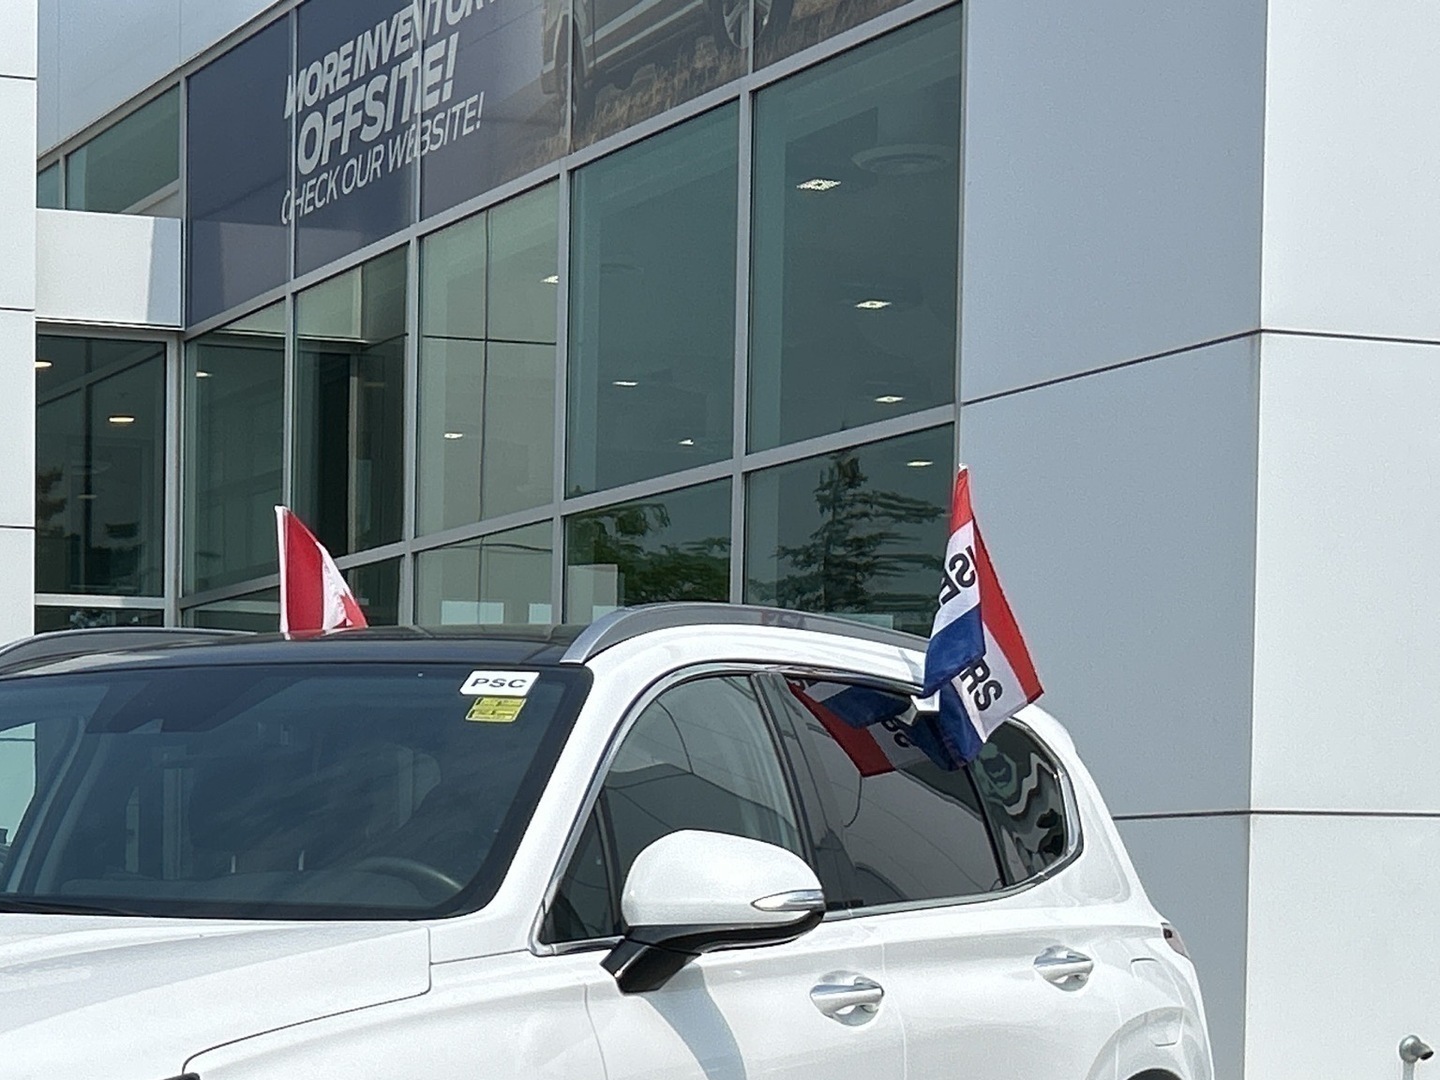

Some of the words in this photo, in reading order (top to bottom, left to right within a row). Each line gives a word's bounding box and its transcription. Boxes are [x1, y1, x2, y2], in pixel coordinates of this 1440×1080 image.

[284, 39, 354, 120] MORE
[353, 0, 496, 80] INVENTO
[297, 32, 459, 175] OFFSITE!
[281, 166, 343, 225] CHECK
[341, 143, 384, 195] OUR
[388, 91, 485, 173] WEBSITE!
[470, 677, 527, 688] PSC
